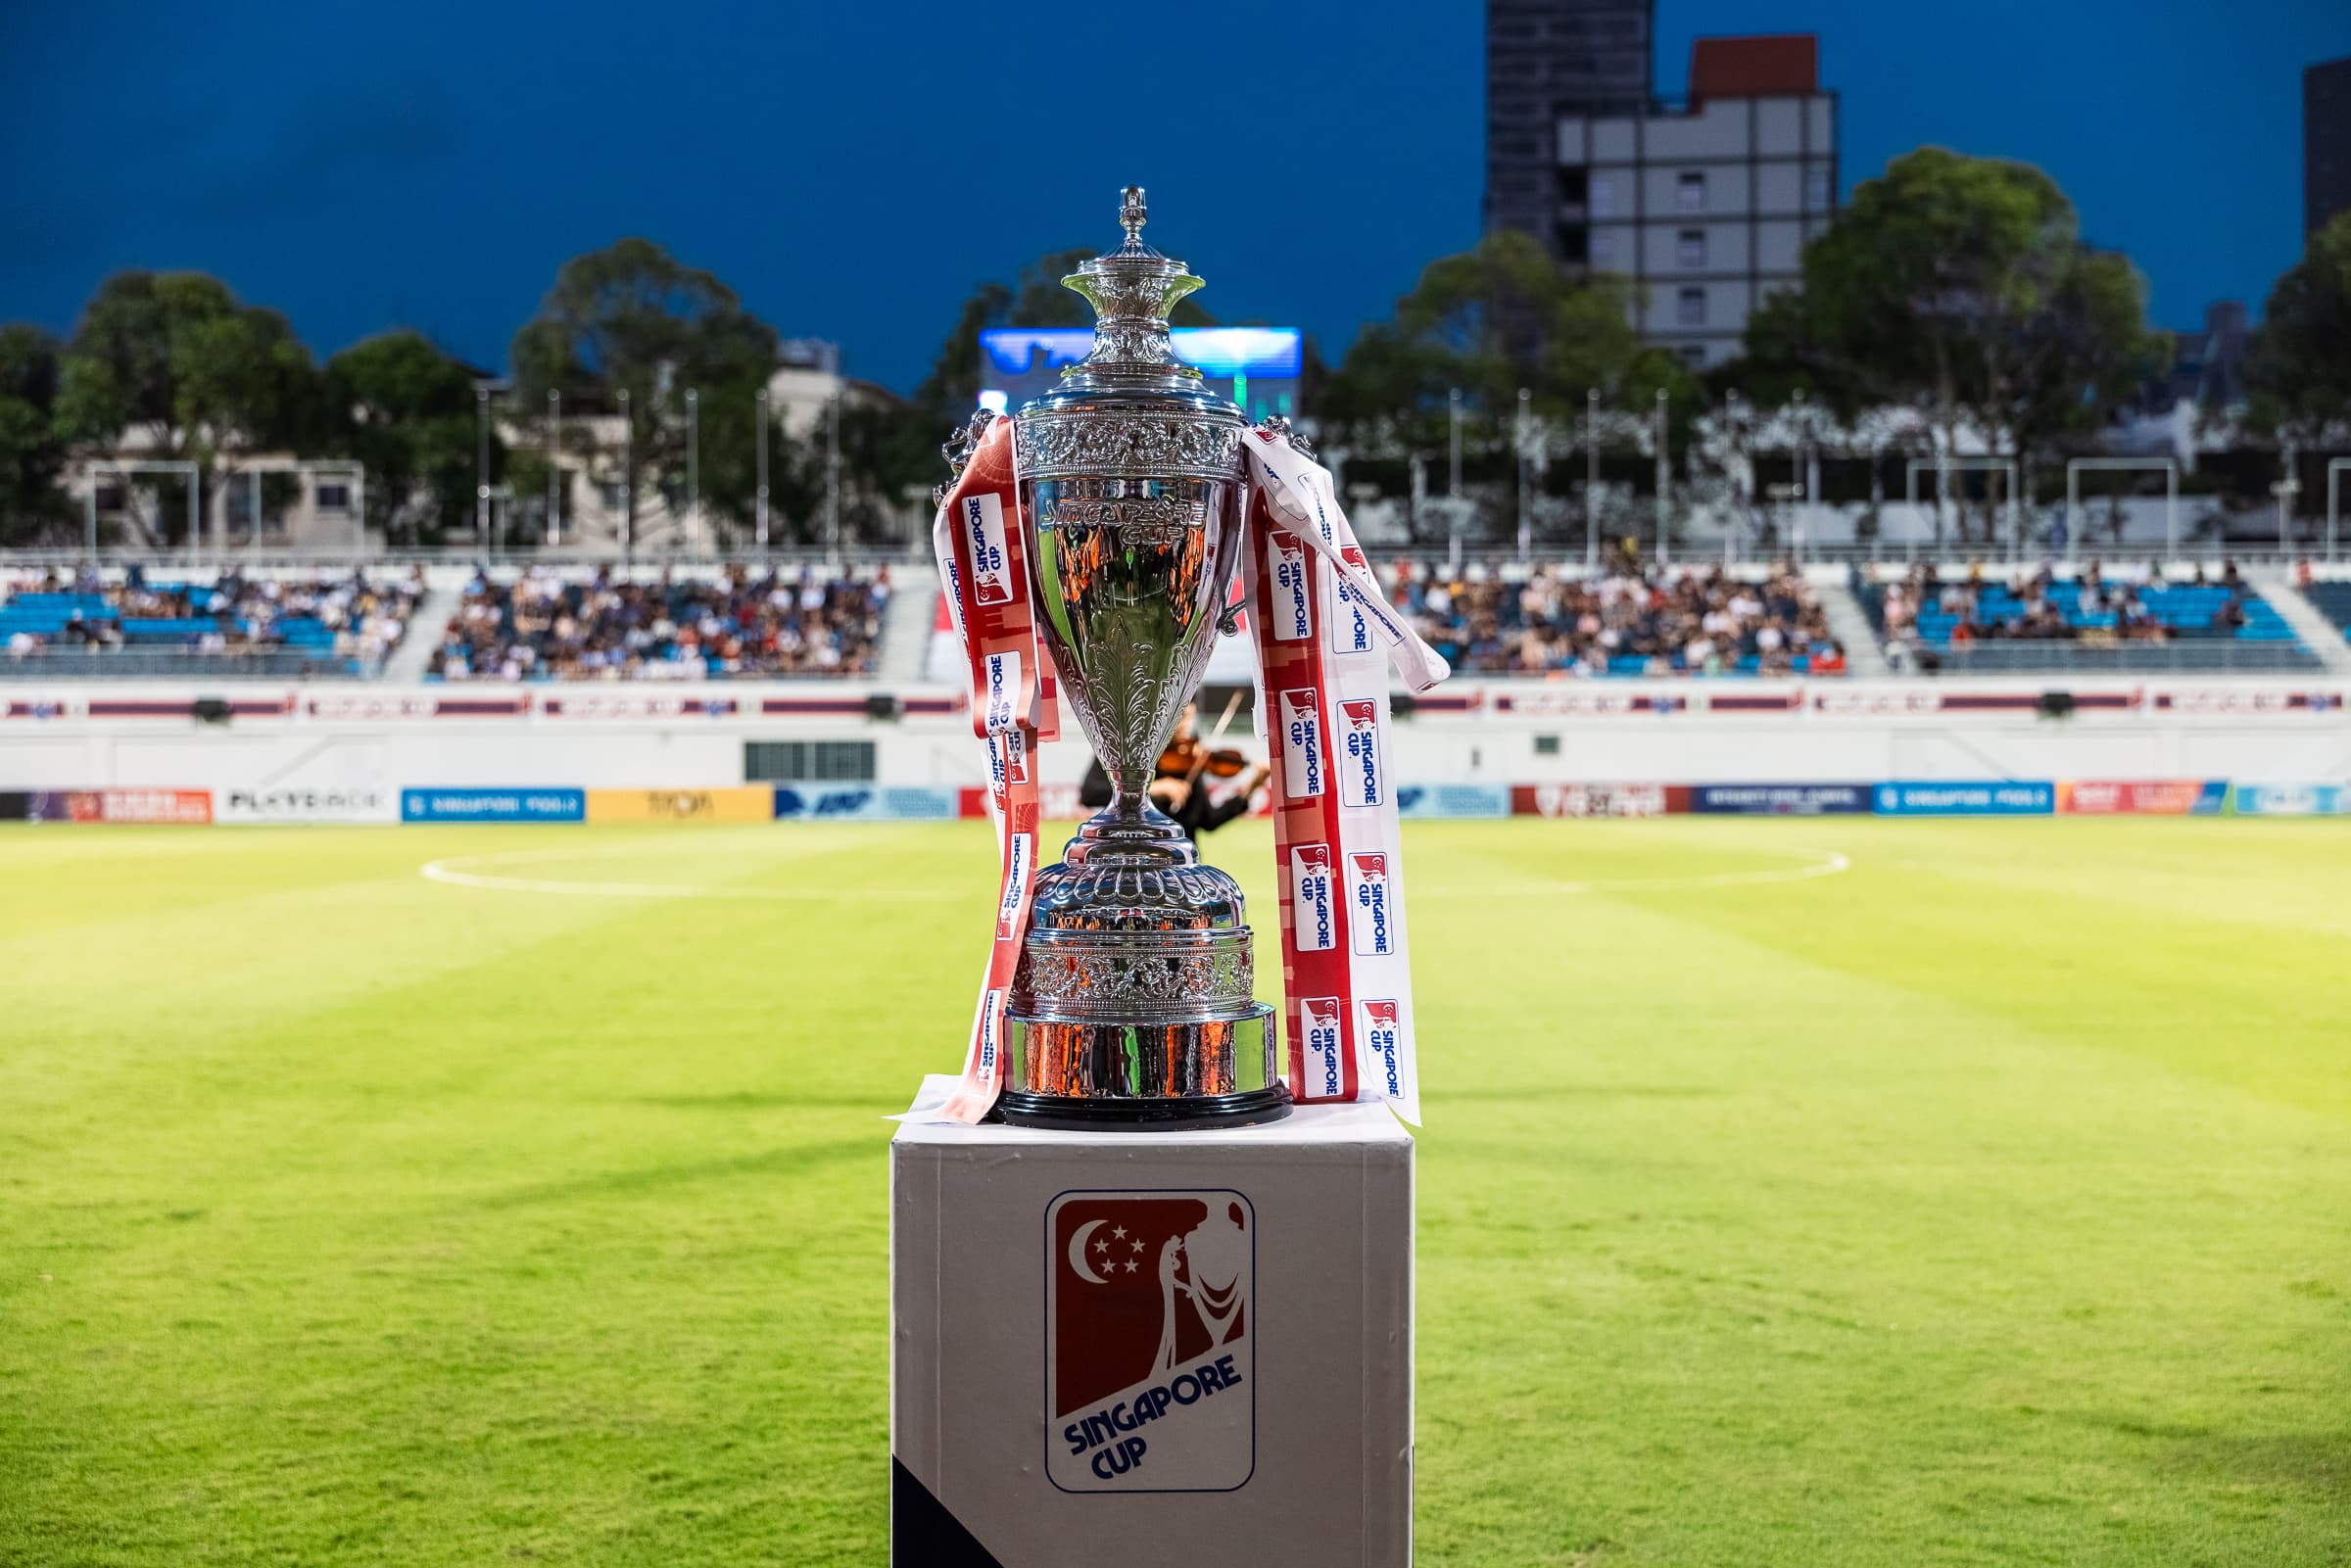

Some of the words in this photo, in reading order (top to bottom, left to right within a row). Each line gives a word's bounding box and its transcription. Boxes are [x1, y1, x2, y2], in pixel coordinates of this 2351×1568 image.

[969, 498, 988, 573] SINGAPORE
[988, 546, 1001, 570] CUP
[1278, 563, 1291, 588] CUP
[1291, 561, 1308, 637] SINGAPORE
[1345, 585, 1364, 605] CUP
[1348, 582, 1404, 640] SINGAPORE
[989, 655, 1003, 727] SINGAPORE
[1000, 701, 1011, 724] CUP
[1290, 721, 1303, 745] CUP
[1304, 720, 1319, 794] SINGAPORE
[1348, 733, 1360, 757] CUP
[1361, 731, 1376, 804] SINGAPORE
[1004, 834, 1021, 908] SINGAPORE
[1011, 884, 1022, 909] CUP
[1302, 877, 1314, 901] CUP
[1359, 883, 1370, 907] CUP
[1315, 876, 1329, 948] SINGAPORE
[1371, 883, 1387, 953] SINGAPORE
[983, 991, 994, 1067] SINGAPORE
[1311, 1028, 1322, 1052] CUP
[1370, 1030, 1382, 1053] CUP
[1323, 1027, 1338, 1095] SINGAPORE
[1382, 1030, 1399, 1097] SINGAPORE
[1063, 1354, 1243, 1456] SINGAPORE
[1090, 1436, 1148, 1481] CUP
